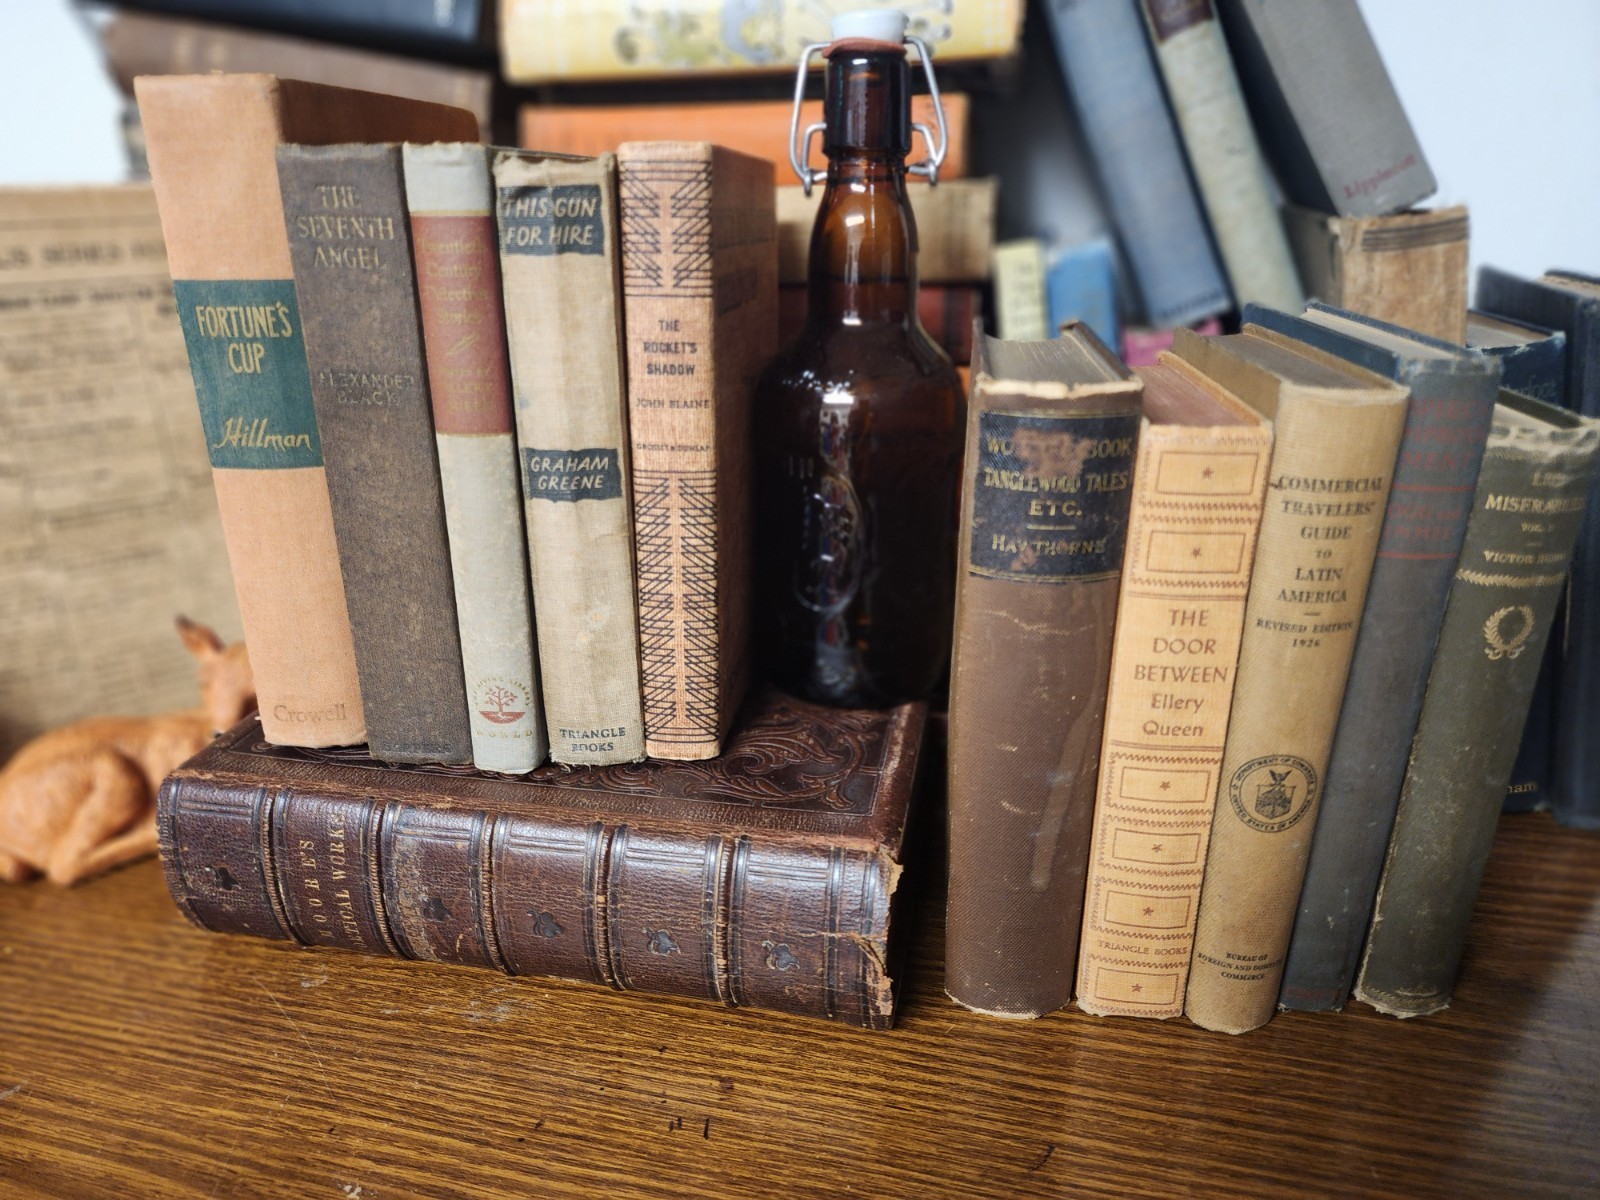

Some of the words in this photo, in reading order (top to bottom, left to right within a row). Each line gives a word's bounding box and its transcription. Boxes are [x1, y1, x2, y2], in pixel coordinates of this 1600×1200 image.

[316, 185, 358, 210] THE
[503, 197, 549, 218] THIS
[554, 196, 597, 218] GUN
[297, 215, 396, 240] SEVENTH
[506, 225, 544, 246] FOR
[549, 224, 594, 246] HIRE
[314, 247, 388, 270] ANGEL
[195, 301, 293, 338] FORTUNE'S
[658, 319, 681, 333] THE
[643, 341, 698, 354] ROCKET'S
[227, 343, 266, 374] CUP
[646, 364, 696, 377] SHADOW
[636, 399, 665, 410] JOHN
[668, 399, 710, 410] BLAINE
[212, 416, 314, 451] Hillman
[530, 456, 609, 473] GRAHAM
[537, 474, 605, 491] GREENE
[982, 467, 1082, 494] TANGLEWOOD
[1085, 472, 1129, 493] TALES
[1278, 475, 1384, 493] COMMERCIAL
[1028, 500, 1084, 517] ETC.
[1300, 525, 1353, 541] GUIDE
[1314, 549, 1333, 560] TO
[1483, 550, 1534, 565] VICTOR
[1294, 567, 1344, 582] LATIN
[1278, 588, 1348, 604] AMERICA
[1168, 608, 1210, 628] THE
[1256, 617, 1308, 634] REVISED
[1152, 637, 1217, 655] DOOR
[1133, 664, 1229, 684] BETWEEN
[273, 703, 347, 722] Crowell
[1150, 693, 1205, 715] Ellery
[559, 726, 627, 739] TRIANGLE
[1142, 719, 1205, 737] Queen
[327, 812, 347, 881] WORKS
[1097, 939, 1150, 956] TRIANGLE
[1153, 945, 1189, 956] BOOKS
[1225, 952, 1257, 962] BUREAU
[1220, 971, 1265, 981] COMMERCE
[1234, 964, 1252, 972] AND
